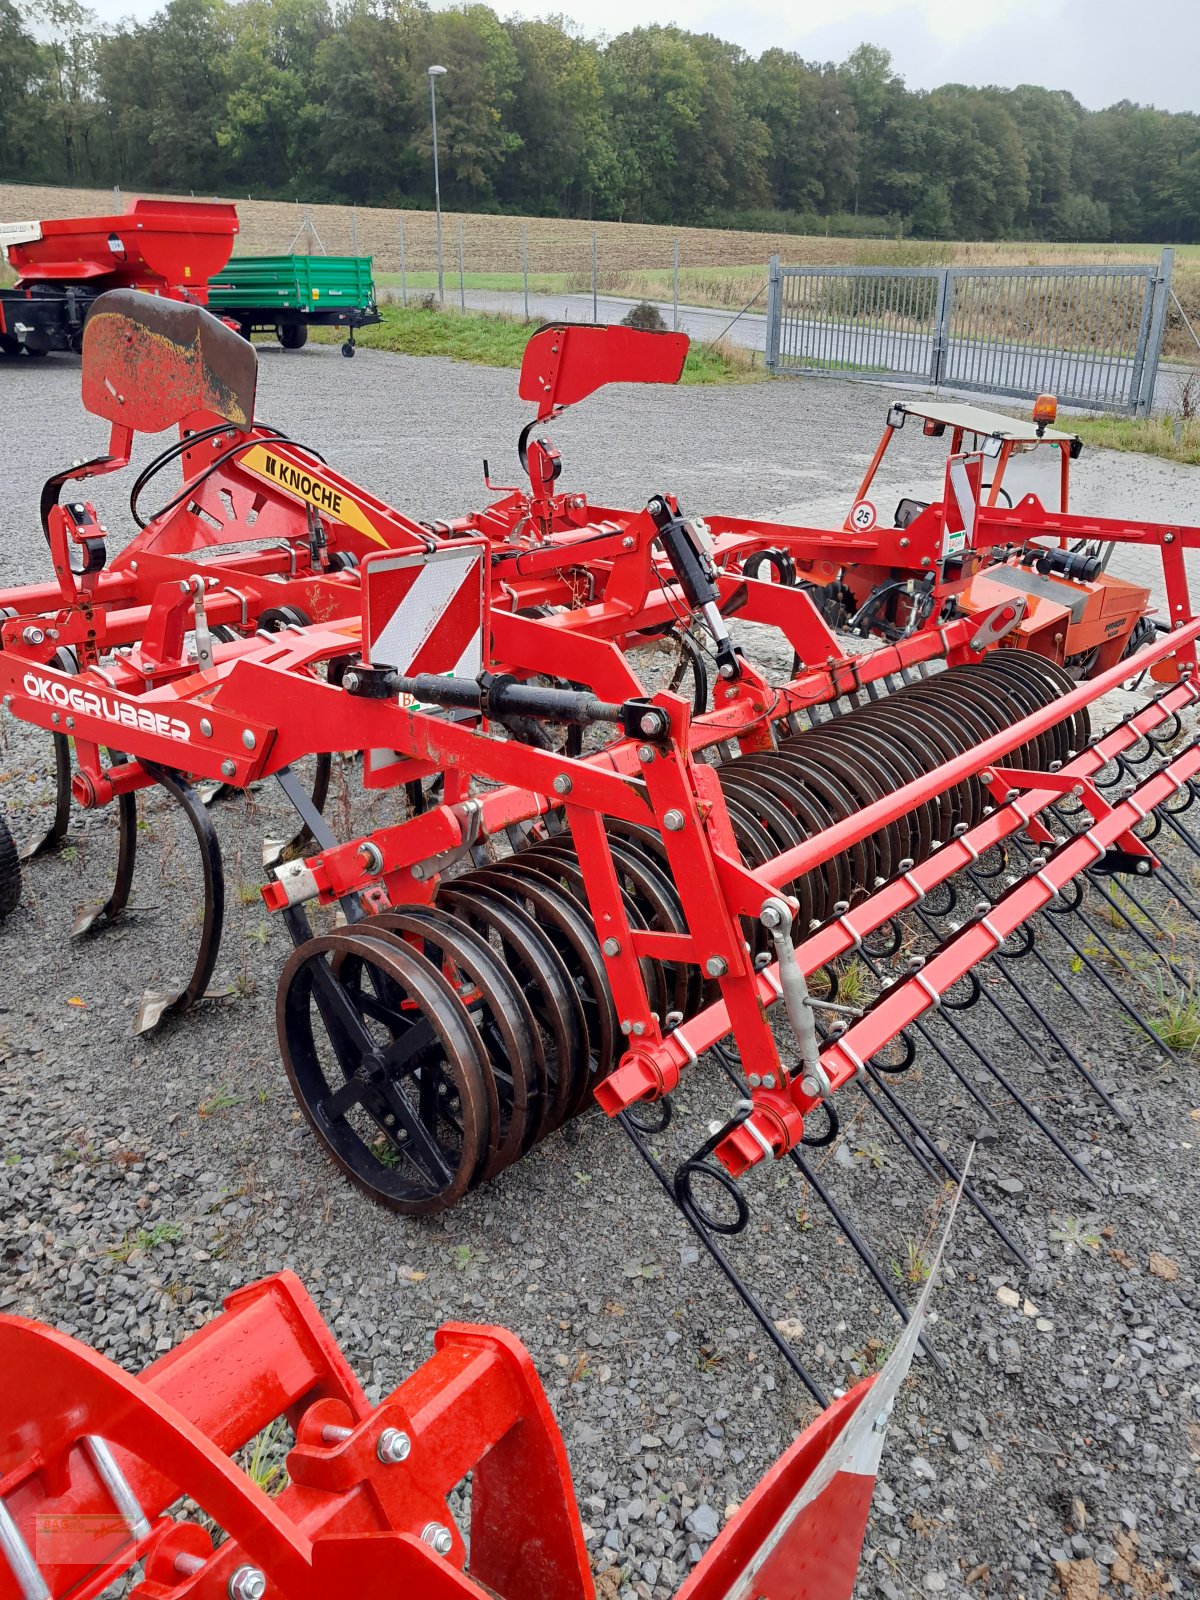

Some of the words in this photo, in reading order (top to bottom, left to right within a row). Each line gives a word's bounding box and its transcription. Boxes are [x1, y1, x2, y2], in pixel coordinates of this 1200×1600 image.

[278, 463, 342, 514] KNOCHE
[856, 509, 870, 524] 25
[23, 672, 191, 741] ÖKOGRUBBER
